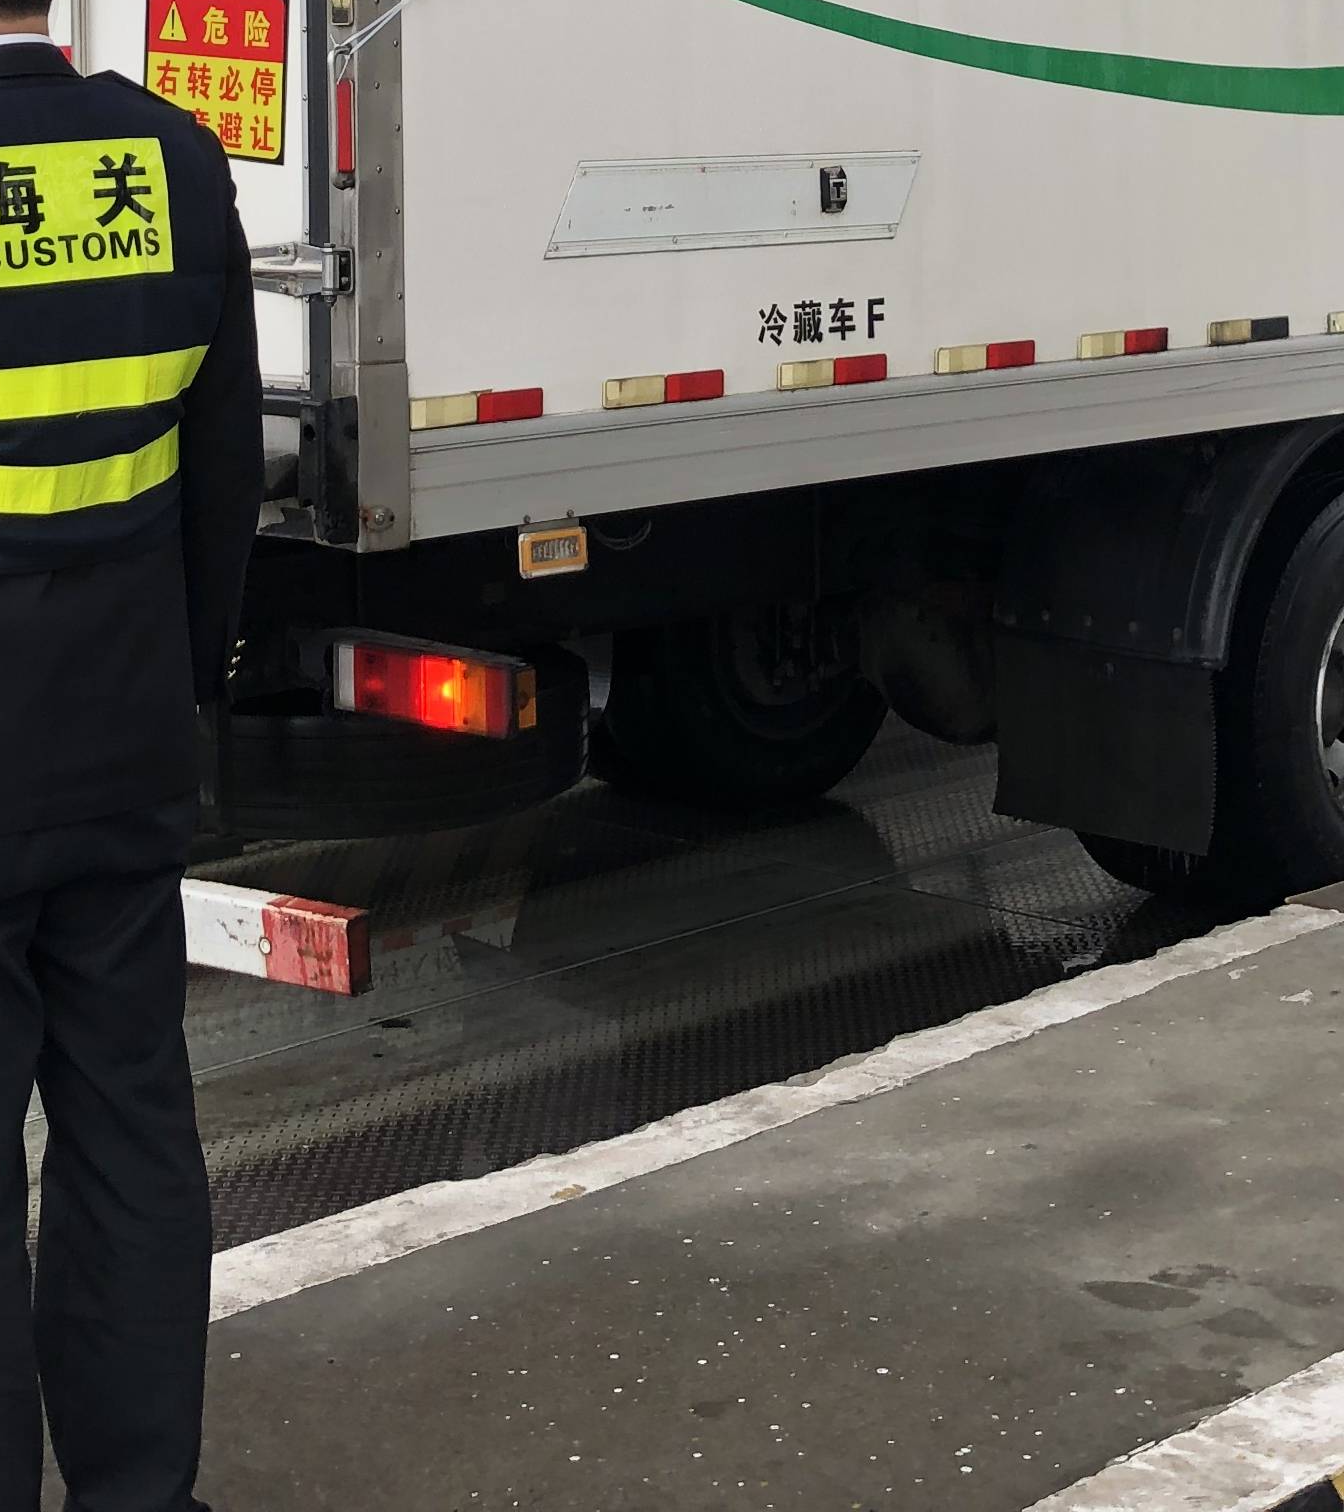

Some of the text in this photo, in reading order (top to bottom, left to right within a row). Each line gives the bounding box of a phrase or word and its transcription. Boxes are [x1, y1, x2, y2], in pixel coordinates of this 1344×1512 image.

[202, 6, 271, 47] 危险
[156, 59, 276, 106] 右转必停
